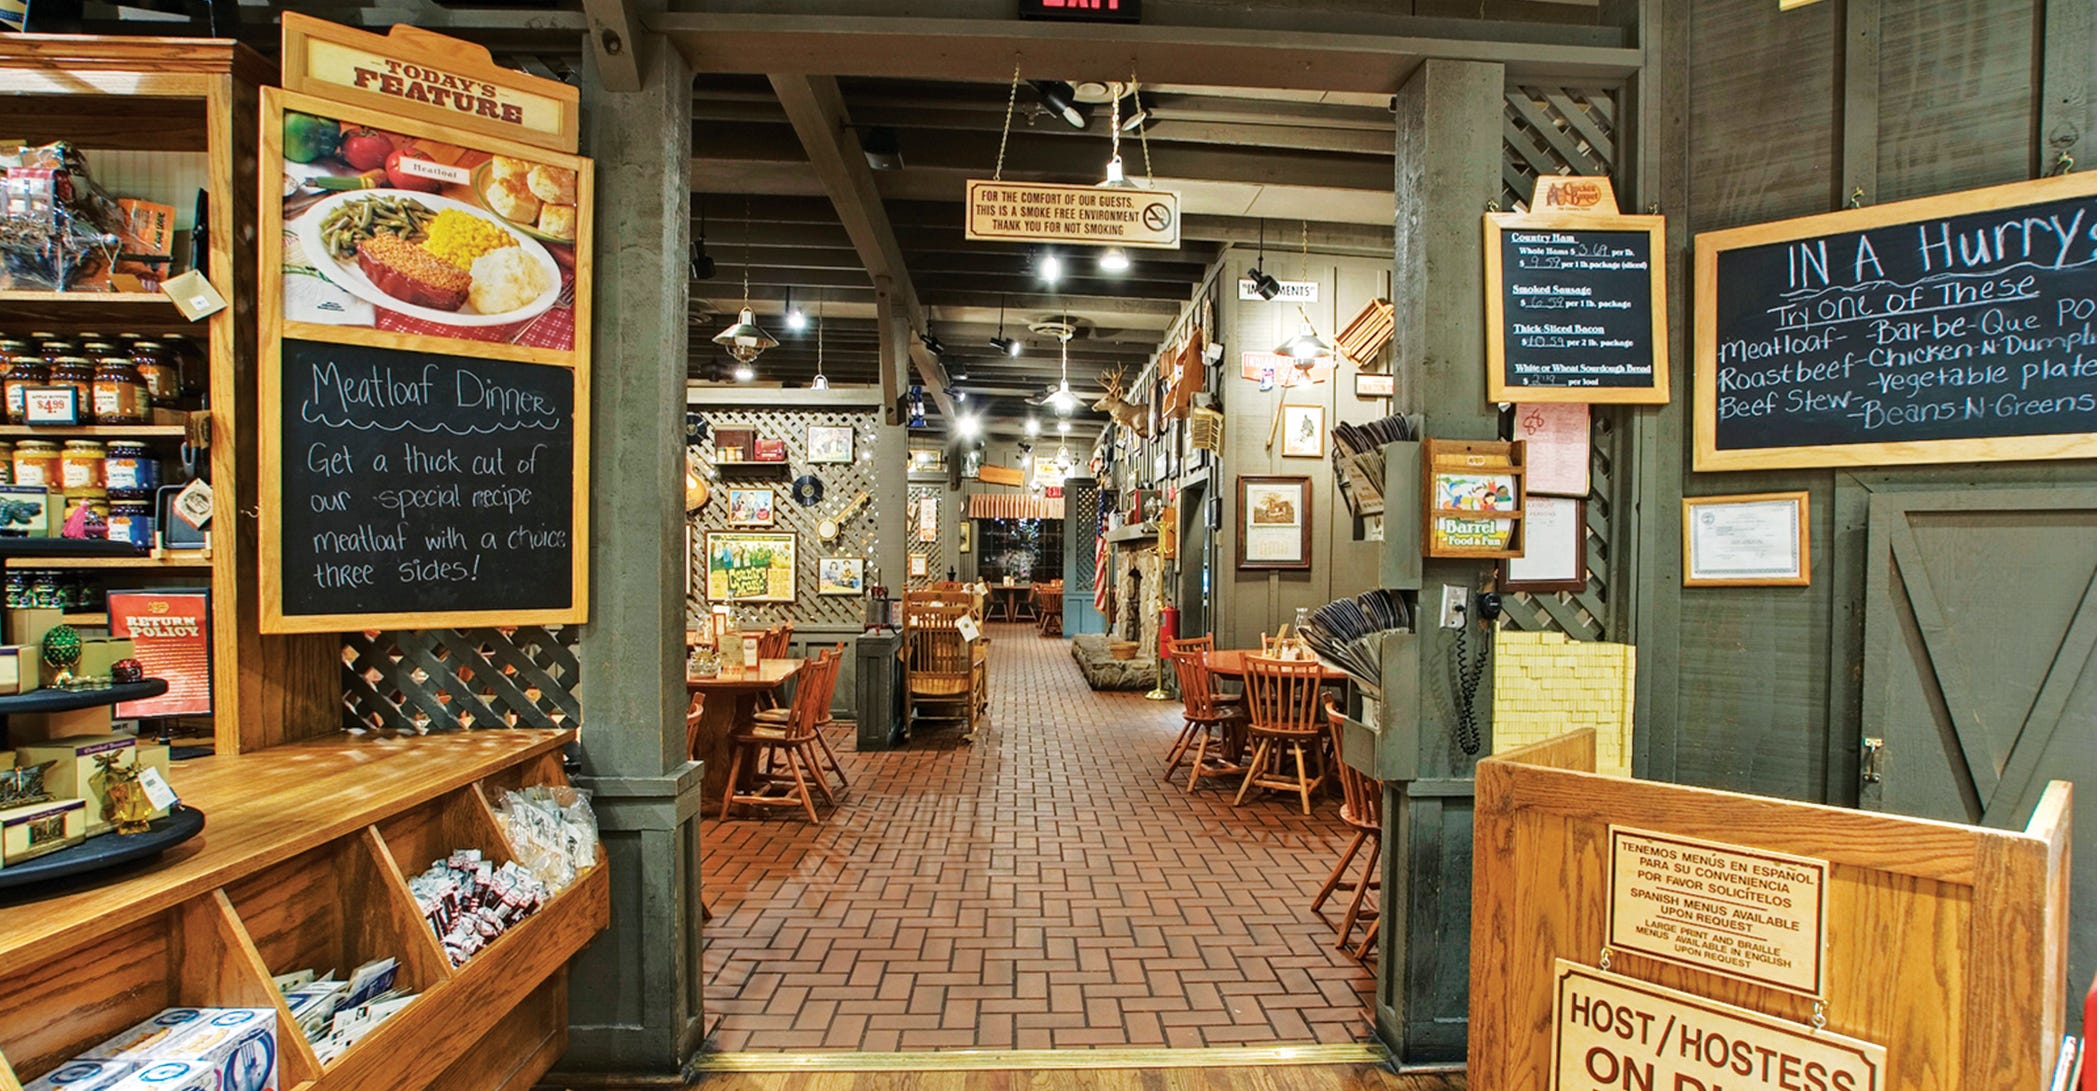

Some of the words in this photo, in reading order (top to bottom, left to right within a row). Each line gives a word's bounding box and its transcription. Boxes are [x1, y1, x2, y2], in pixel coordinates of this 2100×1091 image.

[385, 59, 497, 98] TODAY'S
[353, 66, 523, 125] FEATURE
[981, 190, 998, 201] FOR
[1001, 191, 1018, 203] THE
[1021, 192, 1062, 205] COMFORT
[1064, 194, 1075, 205] OF
[1078, 194, 1096, 206] OUR
[976, 203, 996, 216] THIS
[999, 205, 1008, 217] IS
[1011, 205, 1018, 217] A
[1020, 206, 1051, 219] SMOKE
[1054, 208, 1075, 220] FREE
[1079, 208, 1140, 223] ENVIRONMENT
[992, 218, 1021, 232] THANK
[1024, 220, 1041, 232] YOU
[1044, 221, 1061, 233] FOR
[1064, 222, 1081, 234] NOT
[1084, 222, 1124, 236] SMOKING
[1511, 232, 1551, 243] Country
[1552, 233, 1575, 243] Ham
[1519, 247, 1544, 256] Whole
[1546, 248, 1568, 256] Hams
[1611, 249, 1623, 257] per
[1561, 261, 1574, 270] per
[1788, 240, 1830, 288] IN
[1855, 235, 1884, 282] A
[1512, 284, 1550, 296] Smoked
[1552, 285, 1592, 297] Sausage
[1767, 303, 1810, 332] Try
[1818, 295, 1872, 319] one
[1887, 287, 1925, 314] of
[1934, 275, 2037, 304] These
[1565, 300, 1579, 308] per
[1598, 300, 1632, 310] package
[1513, 323, 1541, 334] Thick
[1544, 323, 1572, 334] Sliced
[1574, 324, 1605, 335] Bacon
[1566, 340, 1580, 348] per
[1600, 340, 1634, 349] package
[1514, 363, 1540, 373] White
[1541, 365, 1551, 373] or
[1552, 363, 1580, 373] Wheat
[1580, 364, 1625, 375] Sourdough
[1627, 364, 1652, 374] Bread
[1567, 379, 1581, 387] per
[1582, 378, 1599, 386] loaf
[312, 361, 439, 413] Meatloaf
[1718, 391, 1779, 423] Beef
[307, 442, 354, 477] Get
[373, 454, 388, 473] a
[404, 442, 463, 475] thick
[472, 448, 505, 475] cut
[517, 443, 548, 474] of
[310, 490, 351, 513] our
[374, 484, 461, 519] special
[472, 486, 533, 515] recipe
[313, 522, 408, 553] meatloaf
[425, 525, 467, 551] with
[481, 531, 497, 550] a
[507, 523, 566, 550] choice
[1445, 518, 1496, 535] Barrel
[1448, 536, 1474, 546] Food
[1481, 536, 1502, 546] Fun
[314, 562, 375, 589] three
[399, 554, 481, 583] sides!
[125, 616, 196, 627] RETURN
[128, 626, 199, 638] POLICY
[1621, 841, 1677, 862] TENEMOS
[1681, 852, 1726, 870] MENÚS
[1730, 860, 1748, 872] EN
[1752, 864, 1815, 885] ESPAÑOL
[1639, 857, 1669, 872] PARA
[1674, 863, 1691, 875] SU
[1695, 866, 1790, 894] CONVENIENCIA
[1637, 870, 1662, 885] POR
[1666, 875, 1704, 892] FAVOR
[1708, 882, 1792, 909] SOLICÍTELOS
[1630, 887, 1680, 907] SPANISH
[1683, 898, 1728, 916] MENUS
[1732, 908, 1800, 932] AVAILABLE
[1660, 905, 1694, 920] UPON
[1696, 912, 1753, 933] REQUEST
[1635, 925, 1670, 942] MENUS
[1675, 934, 1727, 955] AVAILABLE
[1730, 946, 1742, 957] IN
[1745, 948, 1792, 969] ENGLISH
[1645, 919, 1677, 934] LARGE
[1680, 925, 1708, 940] PRINT
[1712, 933, 1734, 946] AND
[1738, 937, 1781, 957] BRAILLE
[1674, 943, 1702, 958] UPON
[1705, 951, 1752, 969] REQUEST
[1585, 1046, 1655, 1091] ON
